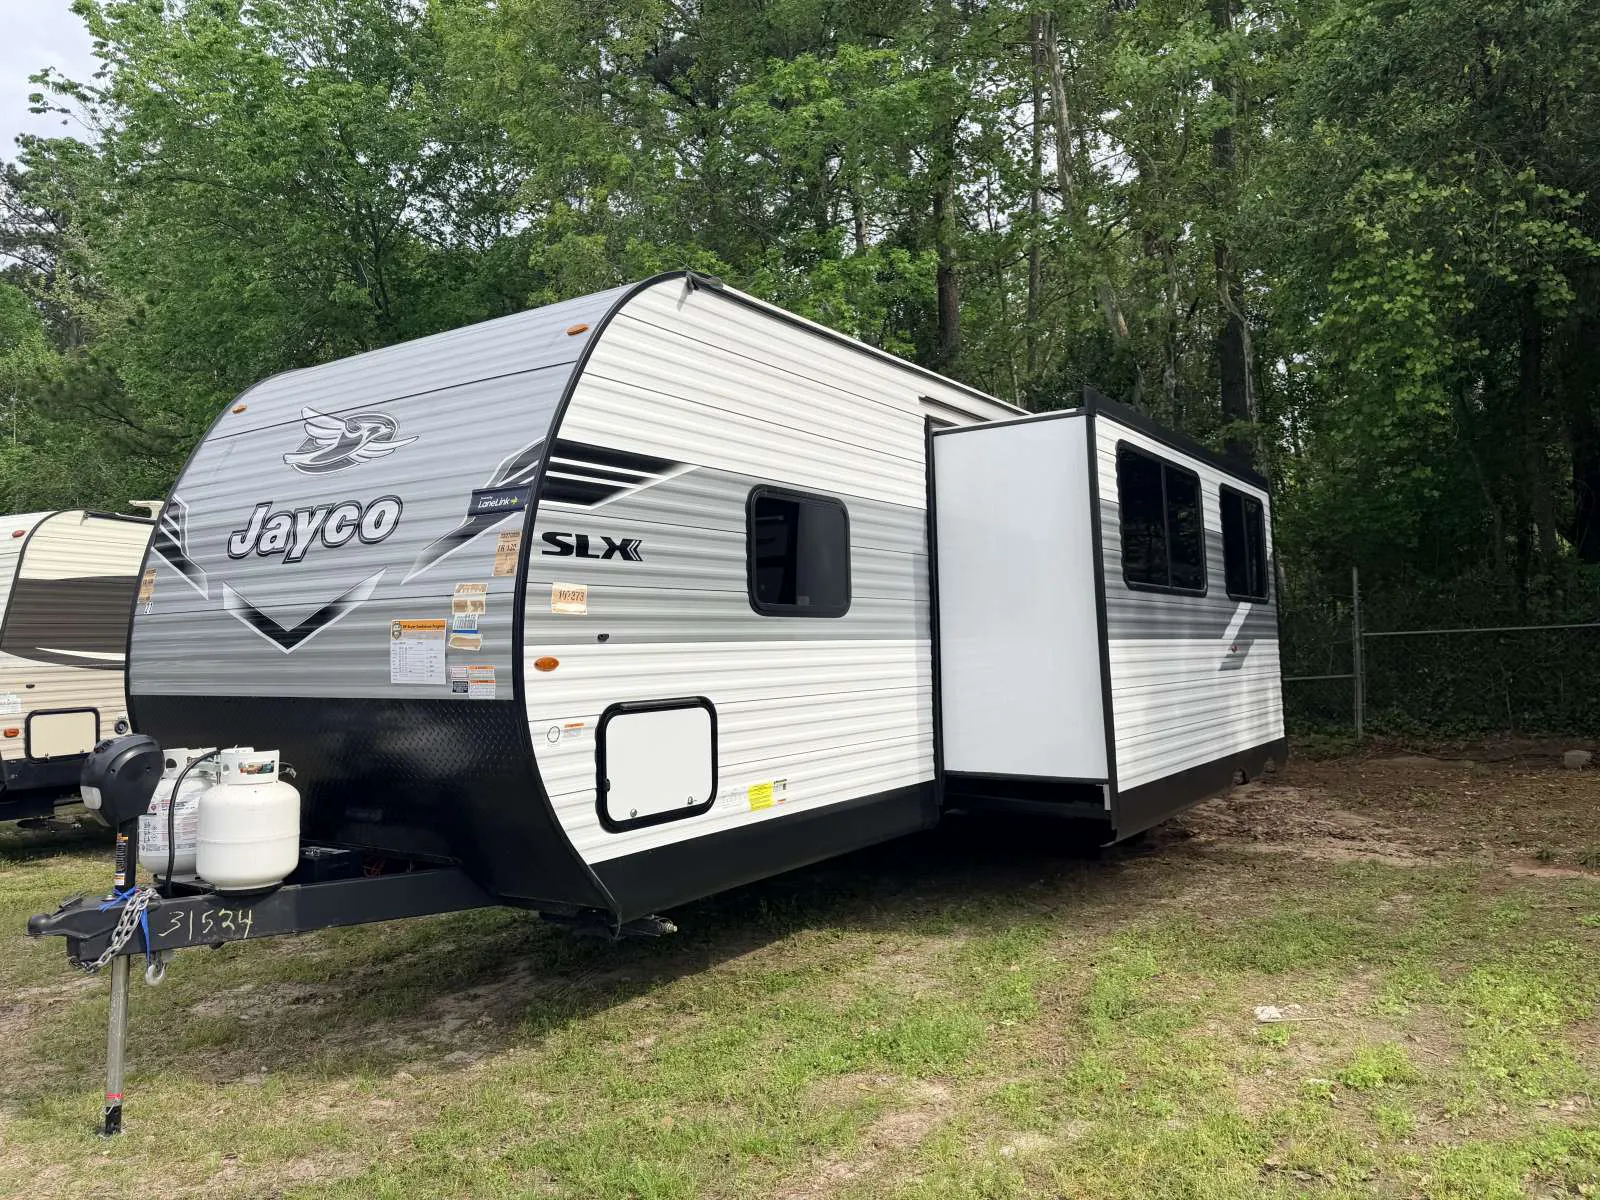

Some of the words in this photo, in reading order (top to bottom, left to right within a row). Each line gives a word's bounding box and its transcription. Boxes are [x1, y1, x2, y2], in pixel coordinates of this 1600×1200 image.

[227, 495, 403, 564] Jayco
[541, 531, 643, 561] SLX
[157, 908, 253, 941] 31524
